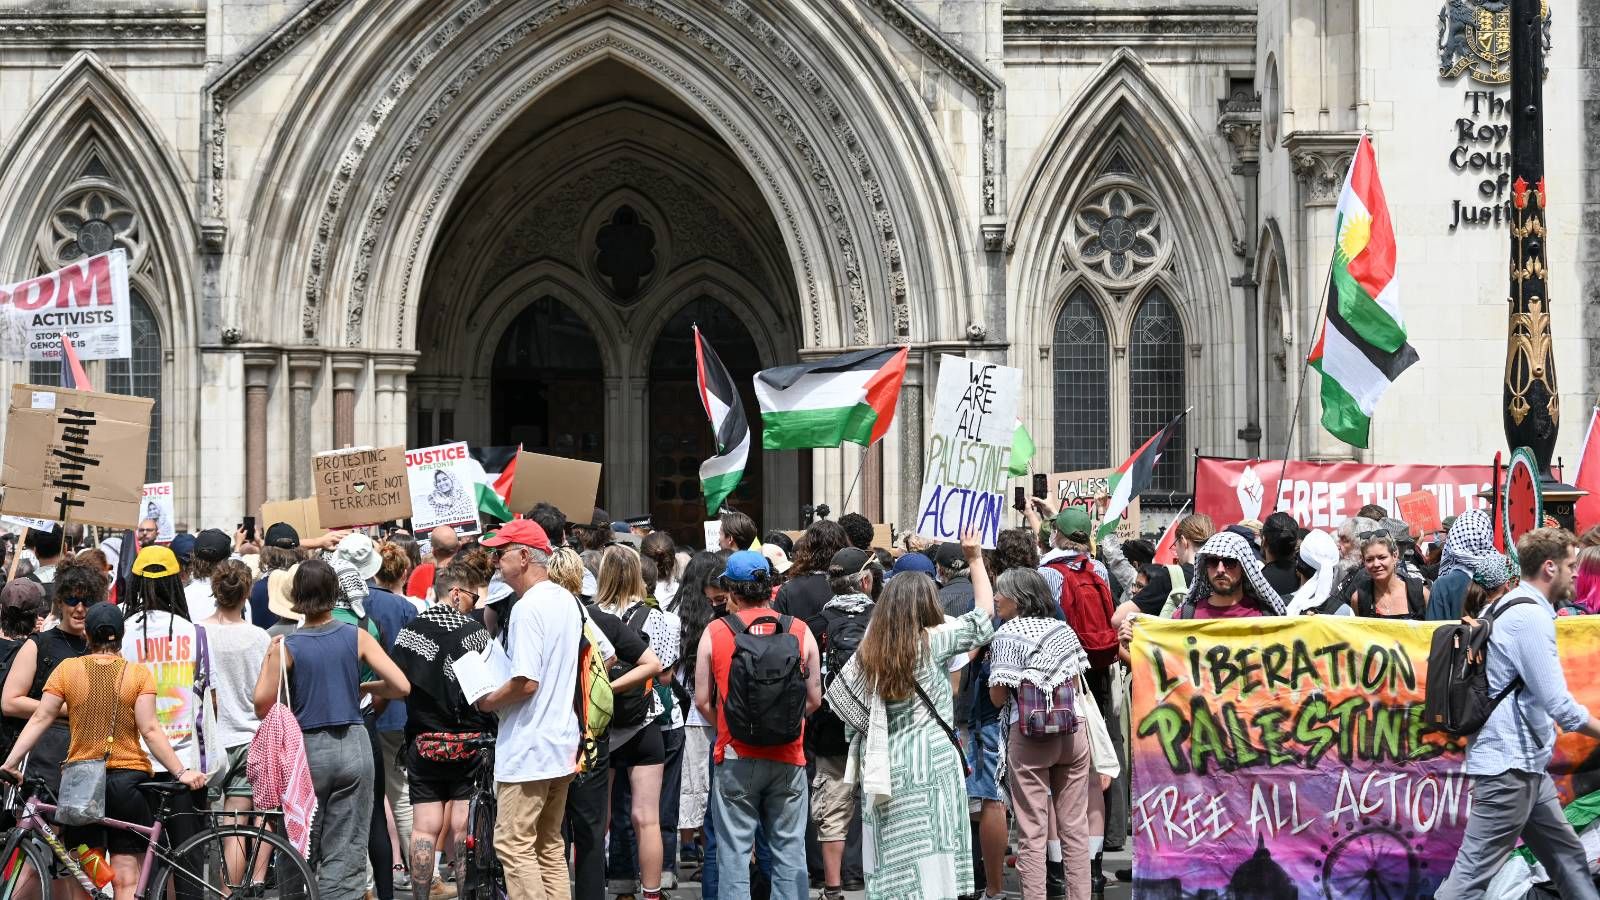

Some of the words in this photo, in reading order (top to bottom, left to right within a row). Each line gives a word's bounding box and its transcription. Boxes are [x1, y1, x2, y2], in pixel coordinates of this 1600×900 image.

[1456, 118, 1511, 147] Roy
[1450, 145, 1511, 170] Cour
[1479, 172, 1510, 198] of
[1449, 200, 1511, 231] Justi
[32, 311, 114, 326] ACTIVISTS
[30, 340, 76, 350] GENOCE
[35, 332, 79, 340] STOPNG
[969, 361, 997, 388] WE
[956, 385, 997, 414] ARE
[956, 408, 982, 442] ALL
[316, 449, 386, 470] PROTESTING
[405, 446, 465, 467] JUSTICE
[925, 432, 1012, 495] PALESTINE
[142, 486, 170, 496] STICE
[329, 486, 338, 496] IS
[384, 475, 403, 488] NOT
[1058, 477, 1110, 499] PALEST
[331, 491, 401, 509] TERRORISM!
[1276, 479, 1346, 529] FREE
[917, 484, 1003, 547] ACTION
[136, 637, 172, 663] LOVE
[176, 636, 190, 660] IS
[1152, 636, 1416, 695] LIBERATION
[1134, 784, 1237, 850] FREE
[1246, 780, 1316, 838] ALL
